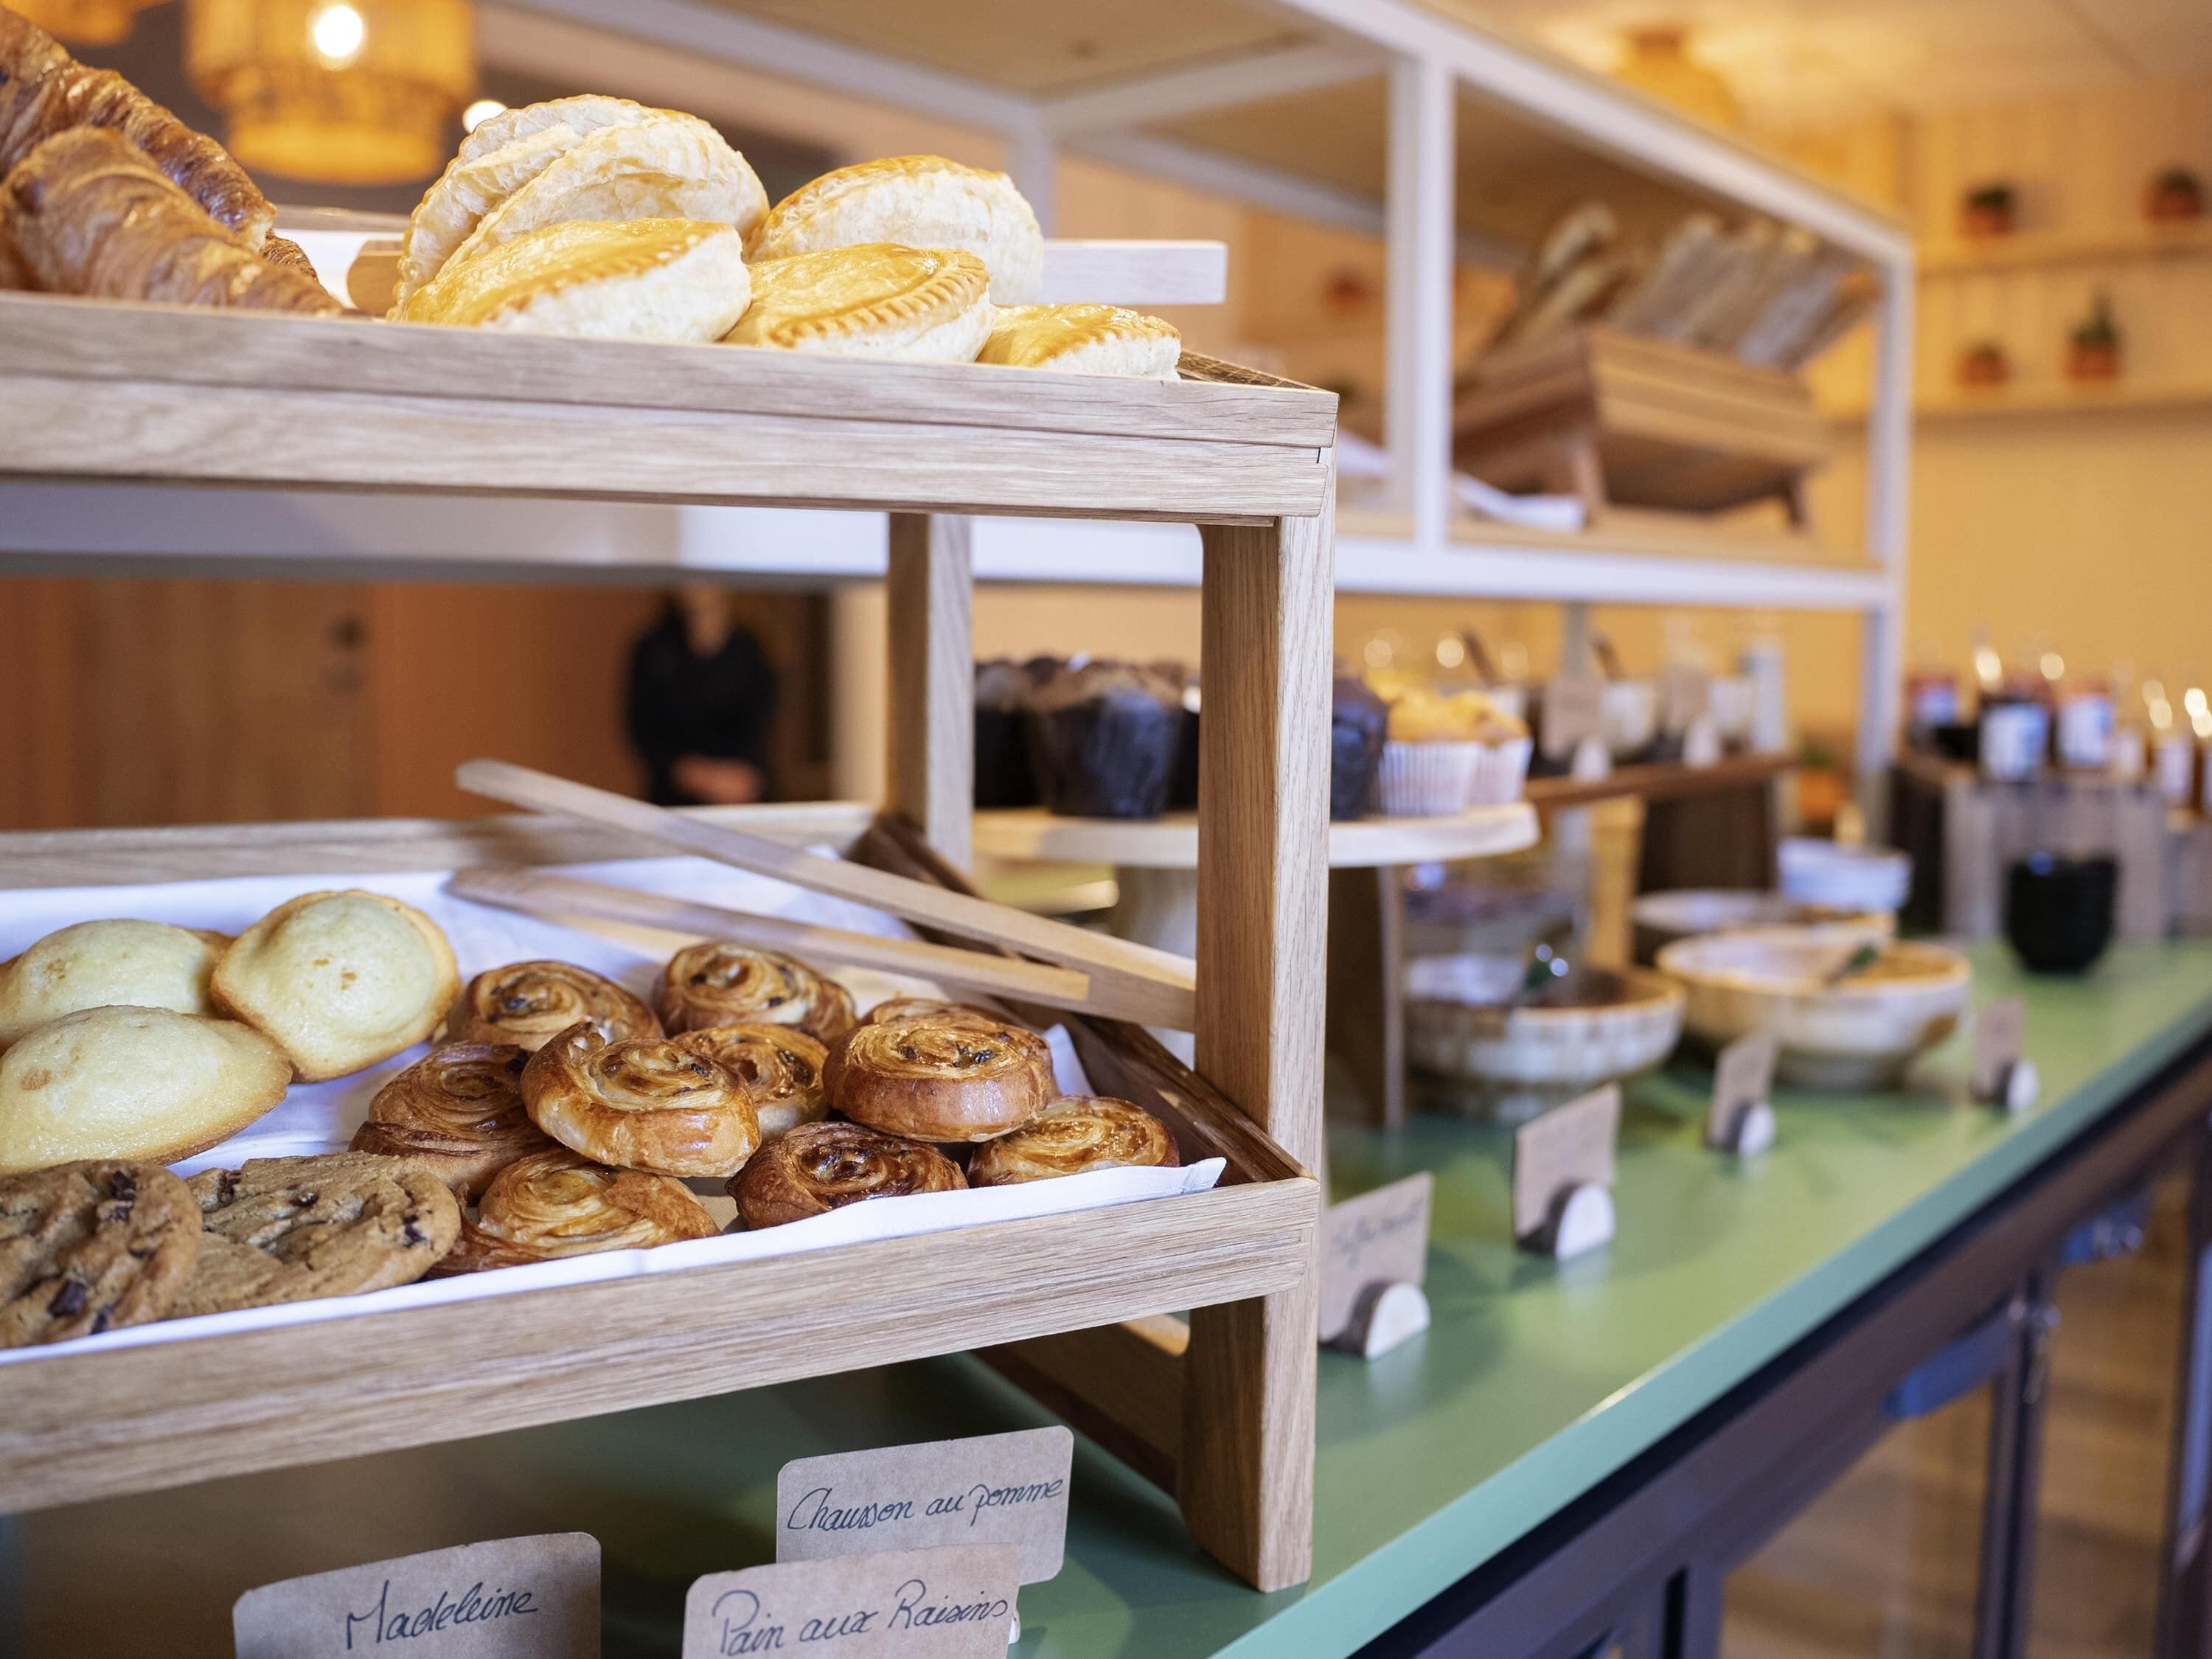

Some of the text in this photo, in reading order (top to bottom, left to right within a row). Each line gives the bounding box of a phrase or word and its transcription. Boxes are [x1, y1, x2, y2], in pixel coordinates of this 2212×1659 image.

[787, 1486, 914, 1531] Chausson
[925, 1492, 964, 1516] au
[346, 1579, 539, 1650] Madeleine
[711, 1579, 1009, 1657] Pain aux Raisins
